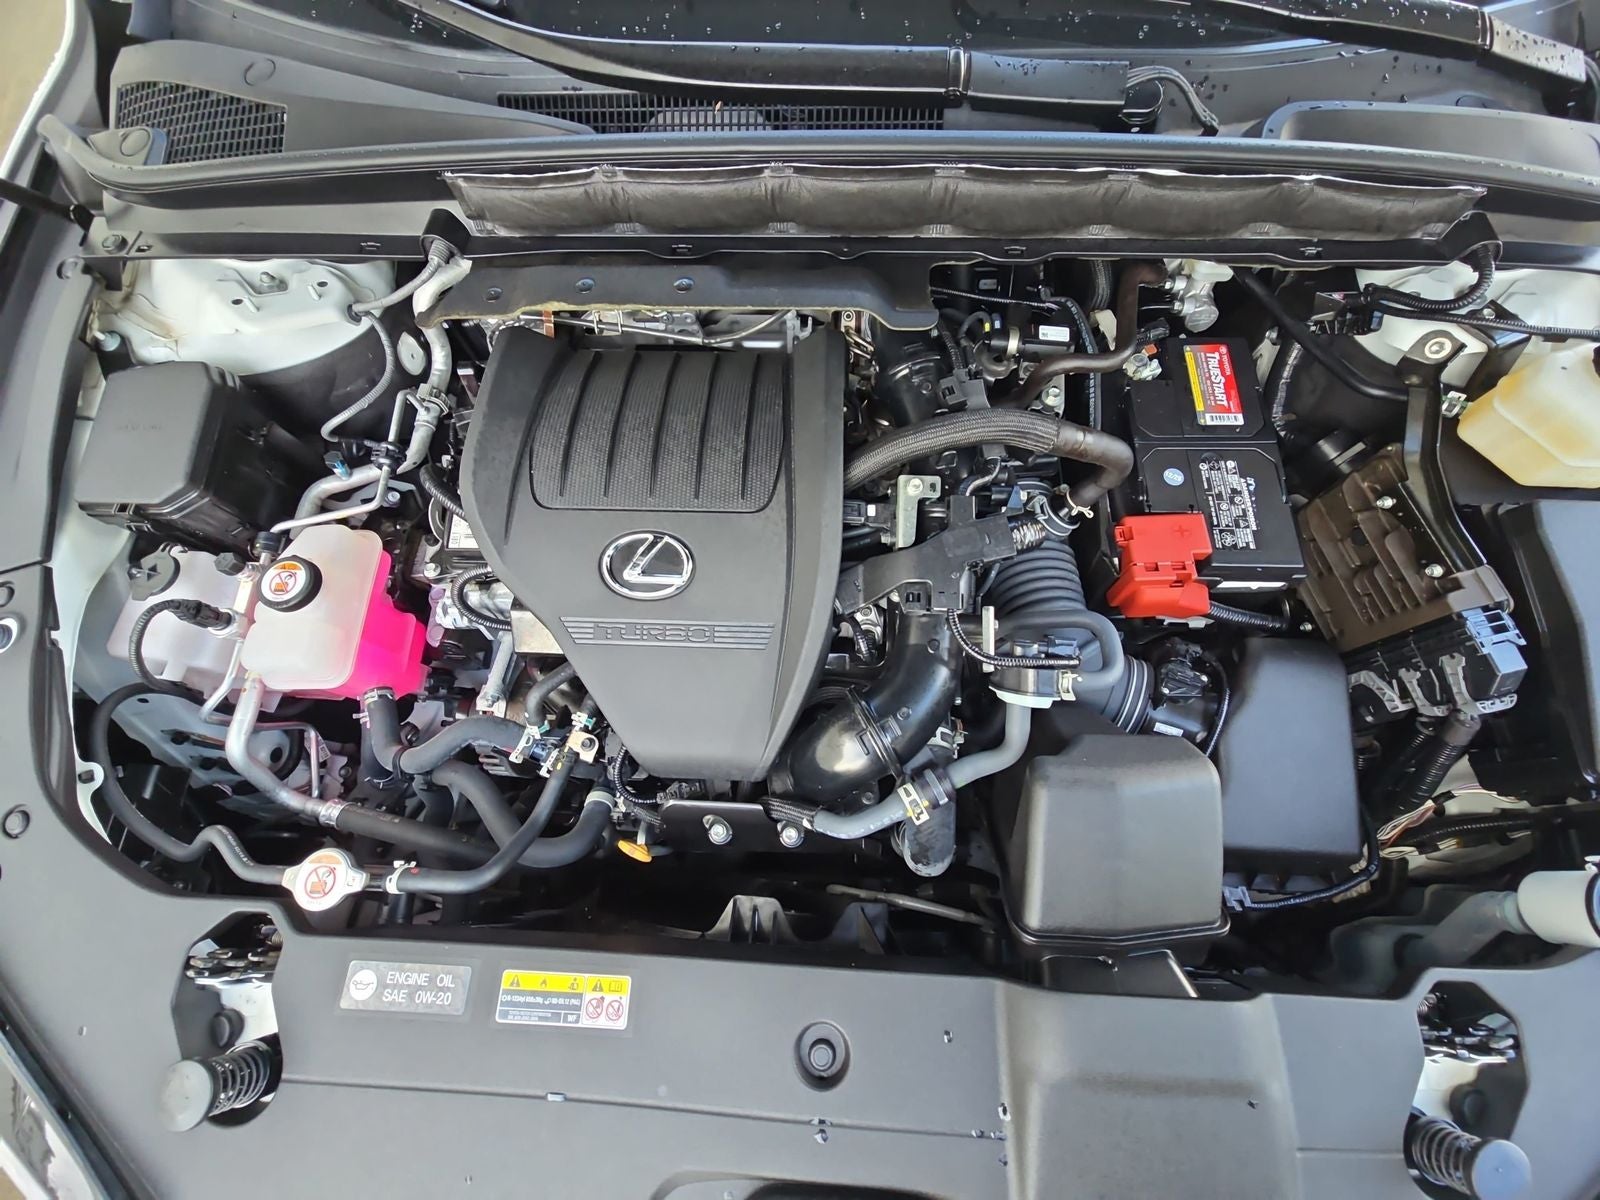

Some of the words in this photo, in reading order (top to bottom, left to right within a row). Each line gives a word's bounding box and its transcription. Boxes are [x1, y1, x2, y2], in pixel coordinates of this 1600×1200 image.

[1222, 354, 1231, 376] TOYOTA
[1206, 351, 1228, 408] TRUESTART
[597, 623, 711, 643] TURBO
[386, 971, 430, 986] ENGINE
[436, 974, 456, 988] OIL
[382, 989, 408, 1003] SAE
[415, 991, 452, 1006] 0W-20
